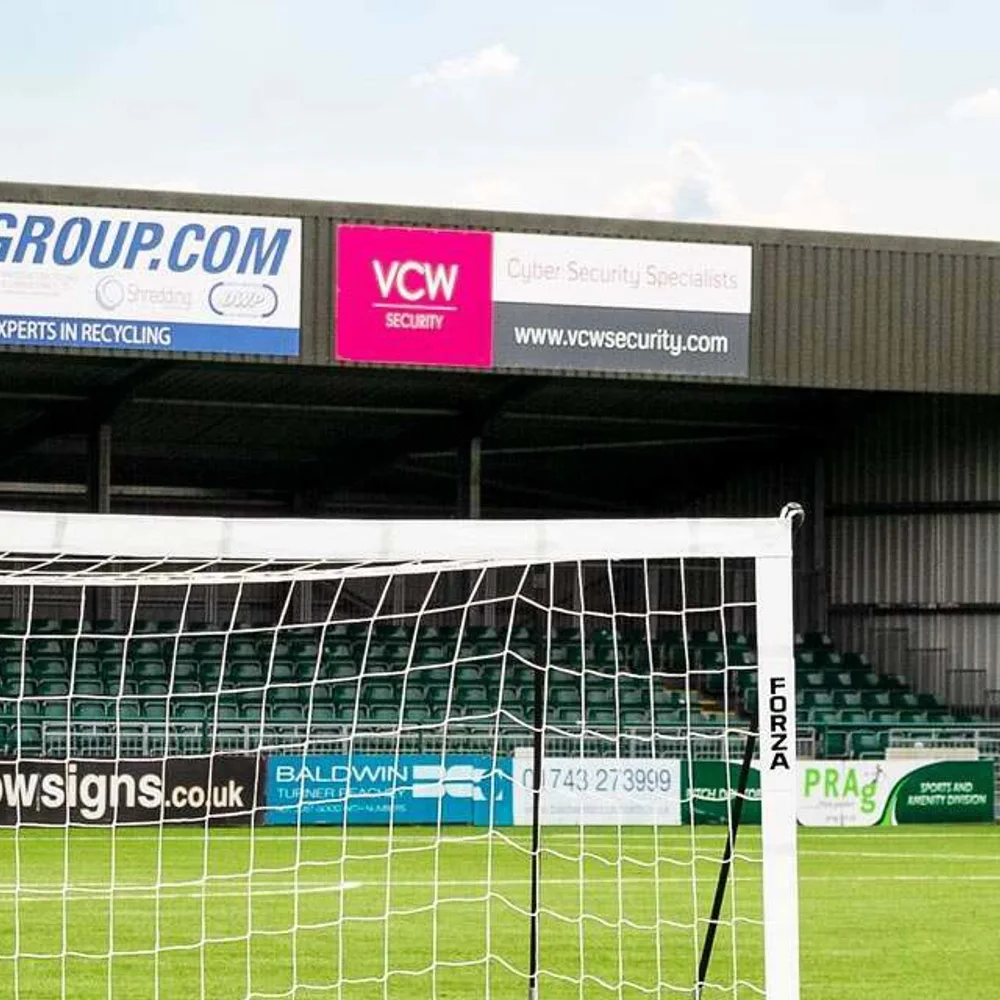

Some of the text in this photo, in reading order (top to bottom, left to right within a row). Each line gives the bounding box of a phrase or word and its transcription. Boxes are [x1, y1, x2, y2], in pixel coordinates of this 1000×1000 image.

[373, 260, 459, 301] VCW
[507, 258, 738, 290] Cyber Security Specialists
[60, 322, 81, 342] IN
[82, 323, 172, 346] RECYCLING
[385, 312, 444, 330] SECURITY
[514, 326, 729, 356] www.vcwsecurity.com
[769, 677, 791, 770] FORZA
[276, 765, 408, 783] BALDWIN
[595, 768, 671, 793] 273999
